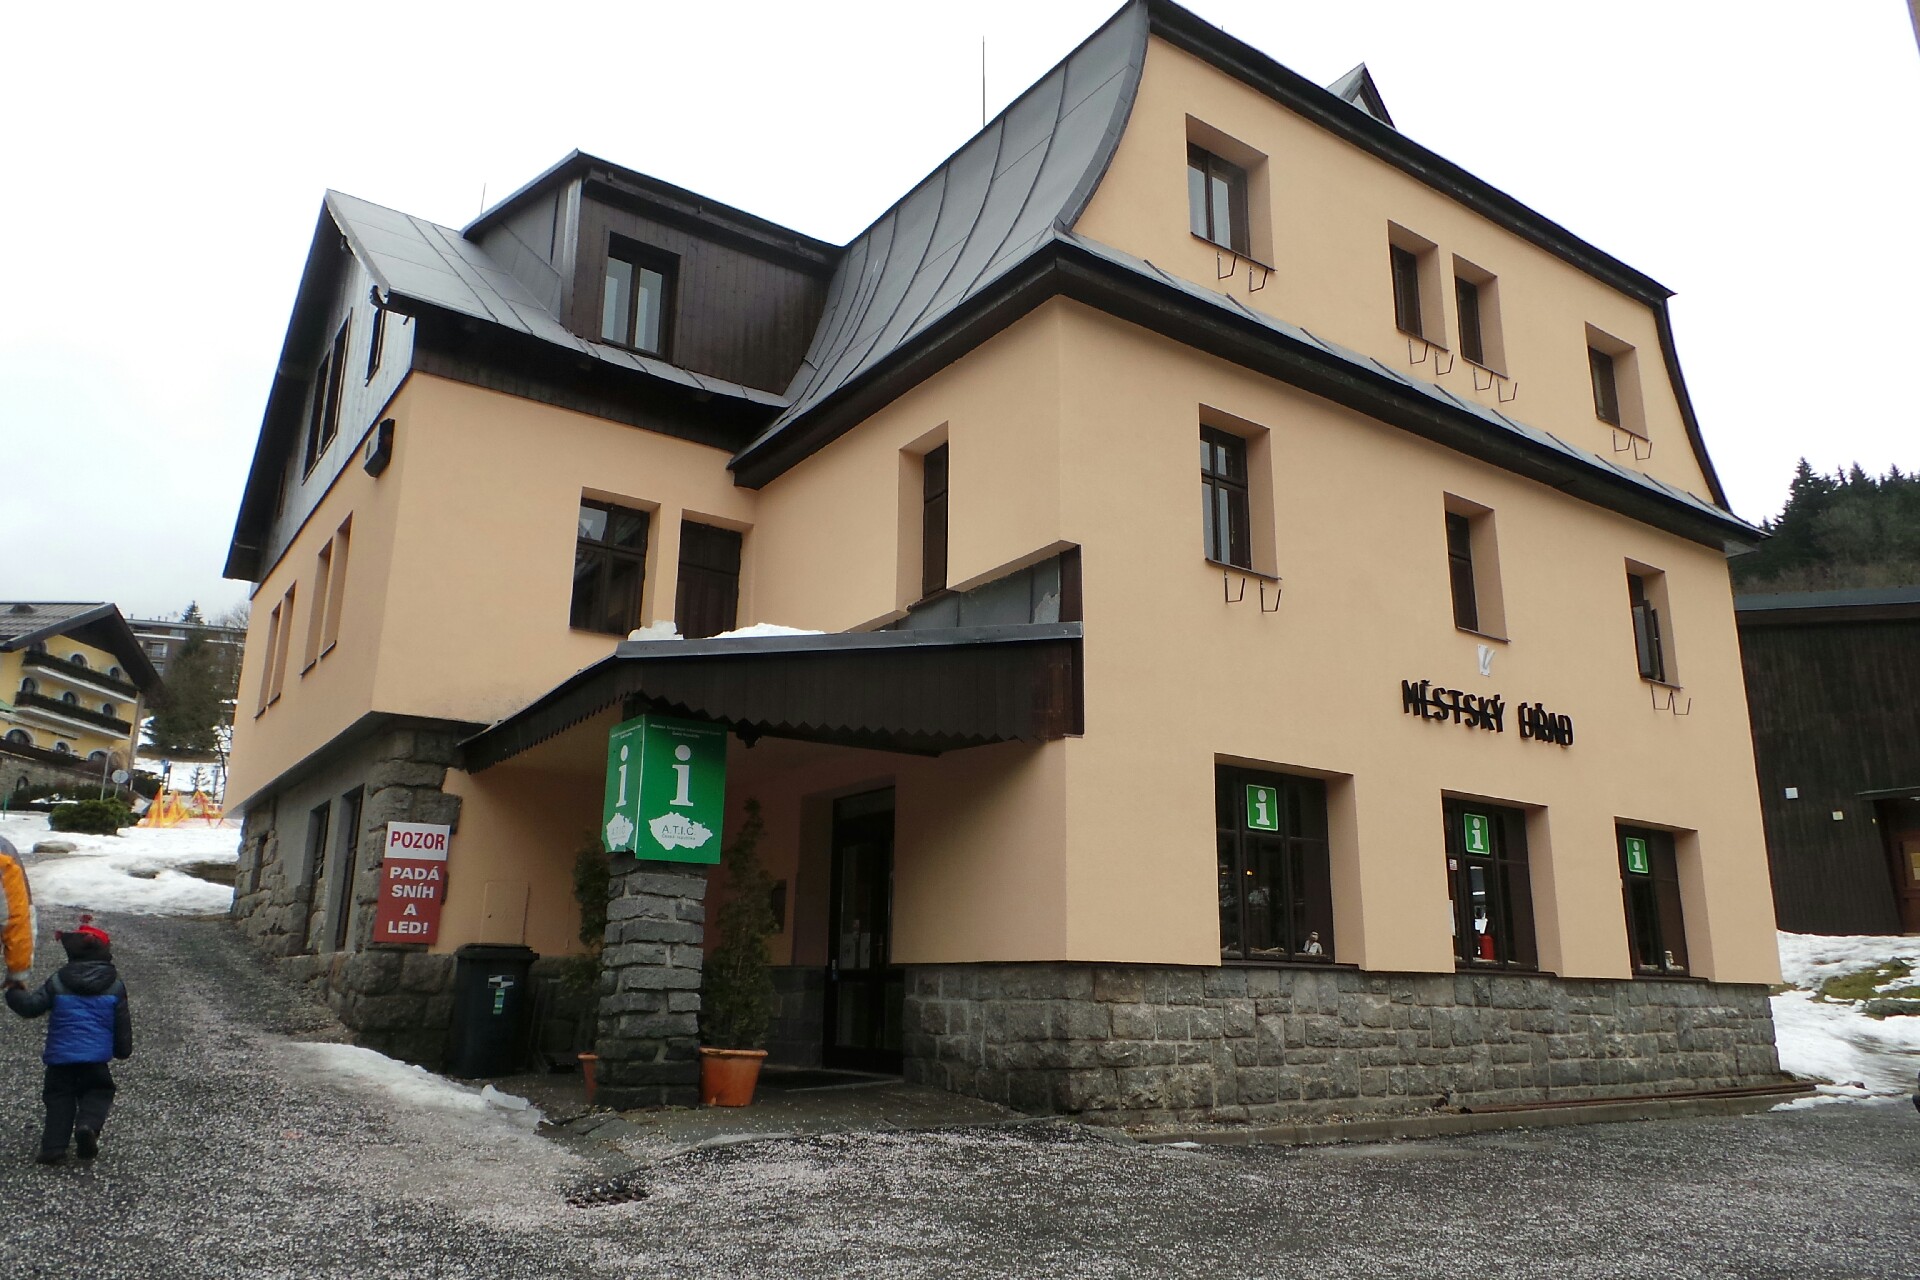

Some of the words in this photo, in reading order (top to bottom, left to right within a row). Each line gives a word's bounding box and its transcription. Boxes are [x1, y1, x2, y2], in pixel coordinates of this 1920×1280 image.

[1401, 679, 1506, 733] MĚSTSKÝ
[1517, 702, 1574, 747] ÚŘAD
[390, 831, 446, 850] POZOR
[389, 866, 440, 881] PADÁ
[391, 882, 434, 898] SNÍH
[403, 903, 417, 916] A
[387, 921, 429, 934] LED!
